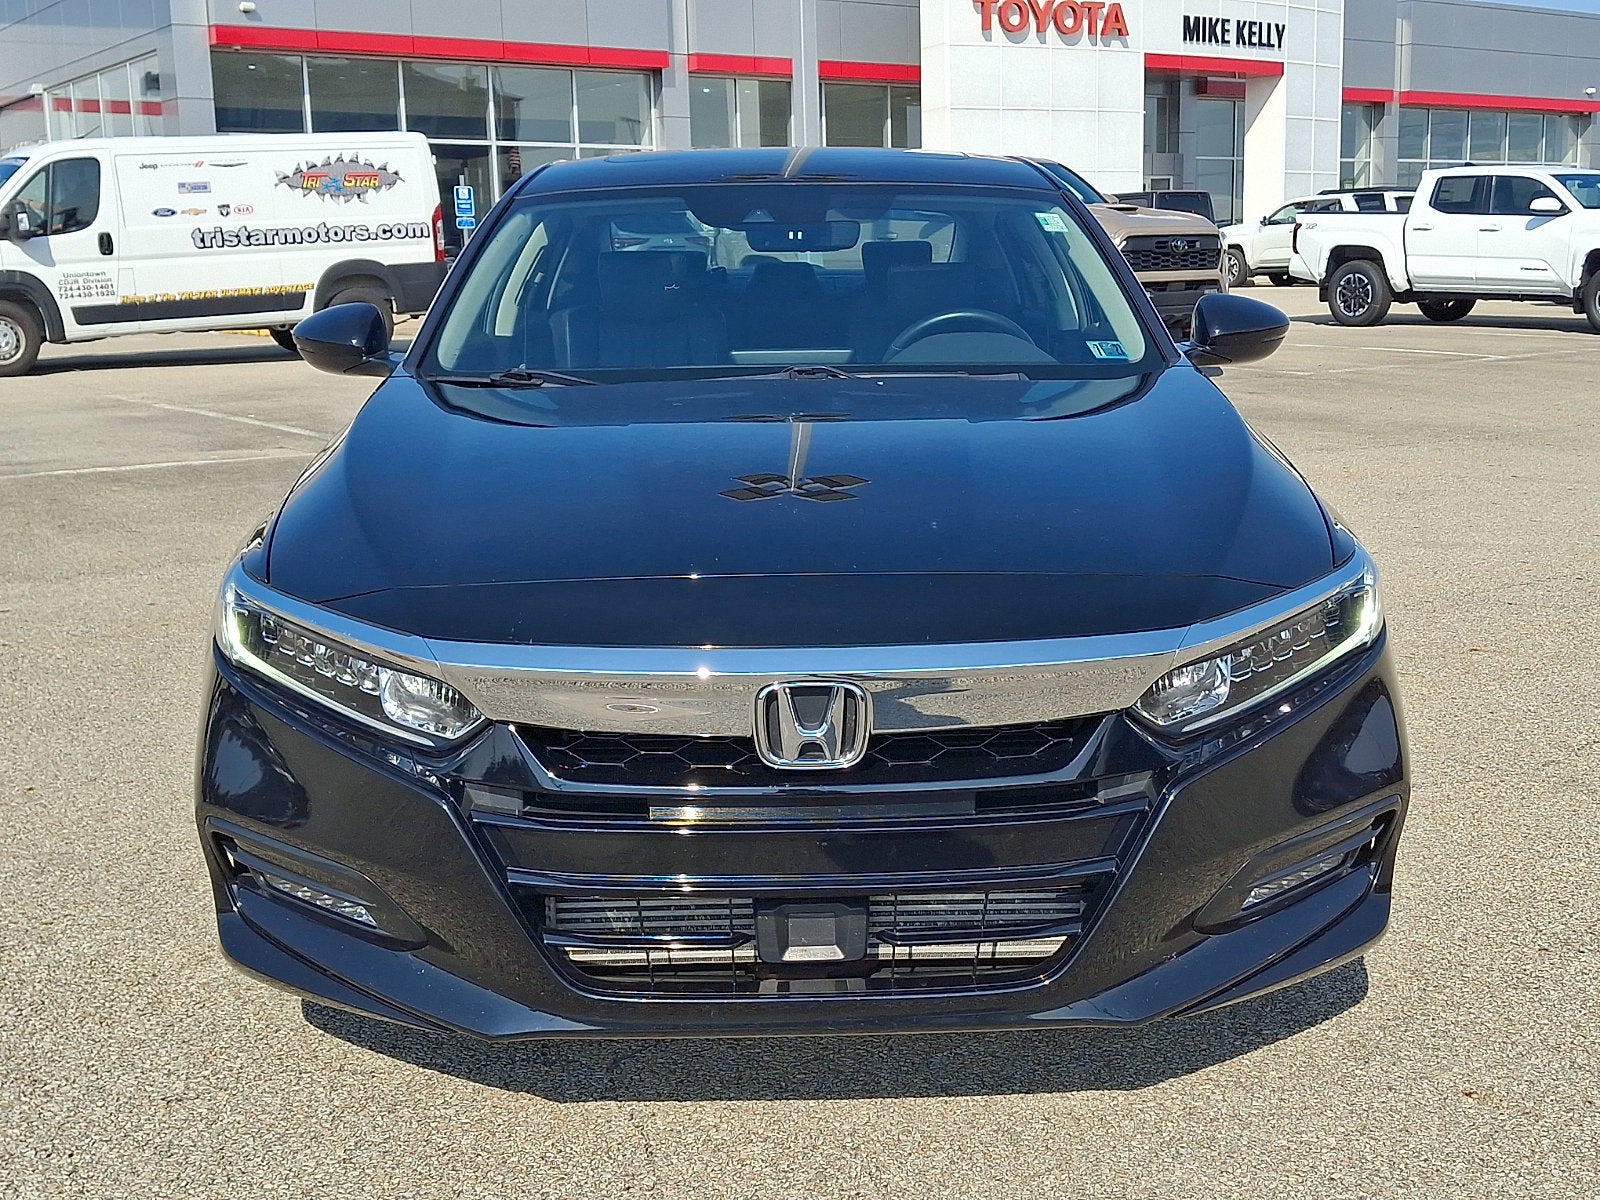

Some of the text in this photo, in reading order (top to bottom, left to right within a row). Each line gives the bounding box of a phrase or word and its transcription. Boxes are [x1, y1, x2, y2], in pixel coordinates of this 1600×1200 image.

[979, 0, 1129, 36] TOYOTA
[1182, 15, 1286, 49] MIKE KELLY
[139, 162, 158, 170] Jeep
[343, 172, 380, 188] STAR
[190, 222, 430, 249] tristarmotors.com
[58, 284, 114, 292] 724-430-1401
[265, 283, 315, 293] ADVANTAGE
